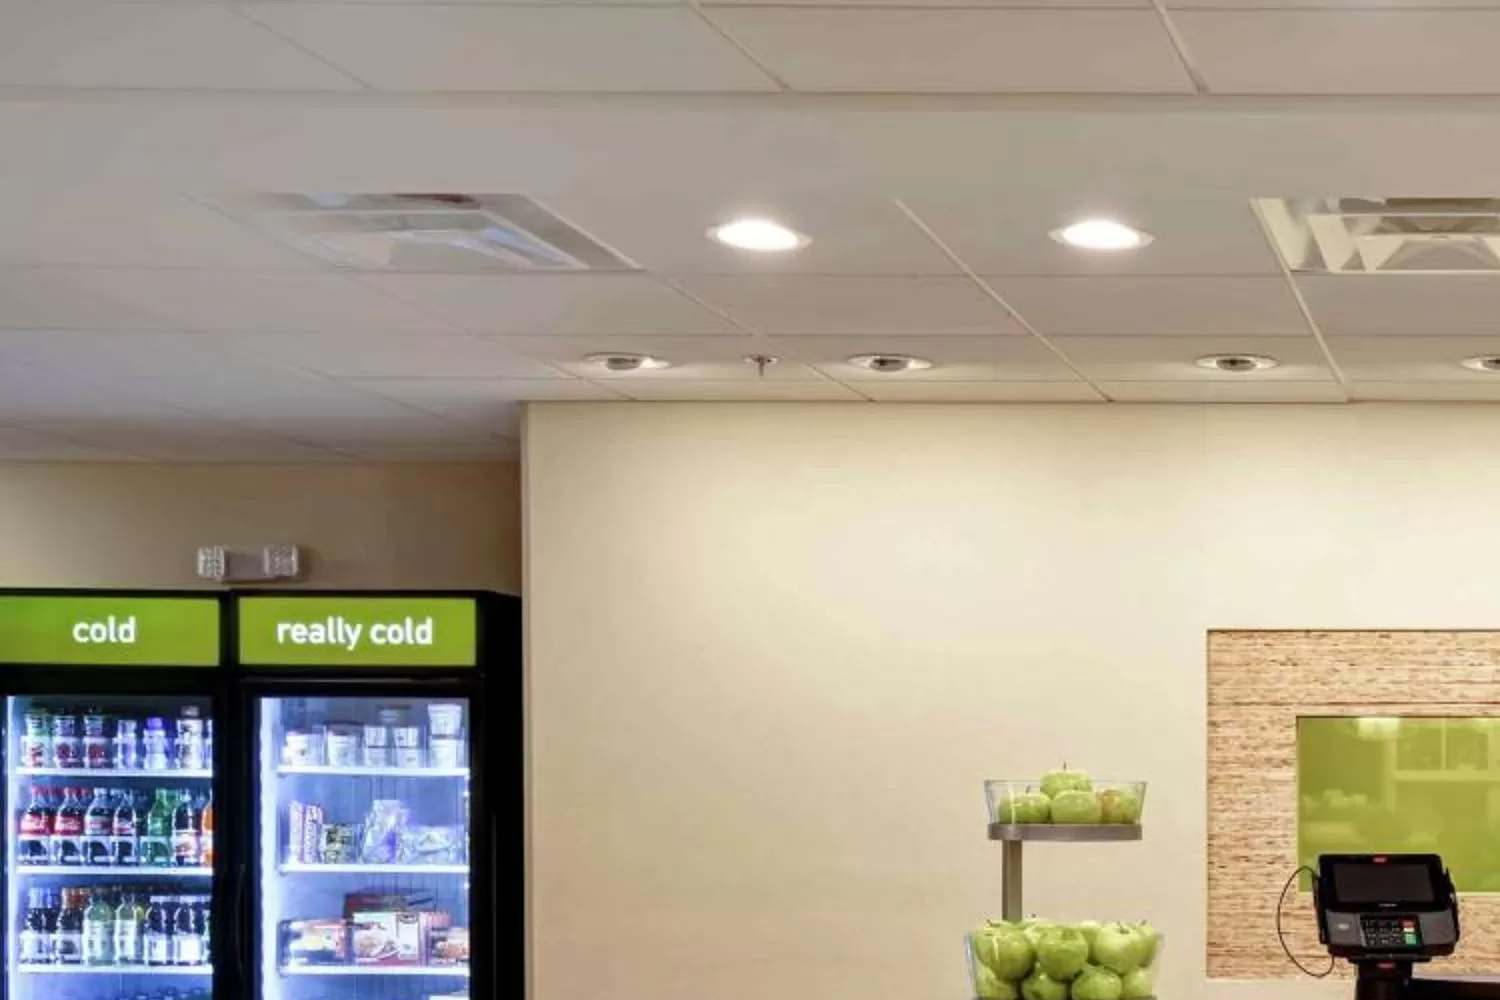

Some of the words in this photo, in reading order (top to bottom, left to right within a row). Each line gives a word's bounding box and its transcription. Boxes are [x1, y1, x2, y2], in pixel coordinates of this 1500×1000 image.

[73, 615, 137, 644] cold
[276, 616, 363, 651] really
[370, 617, 434, 645] cold
